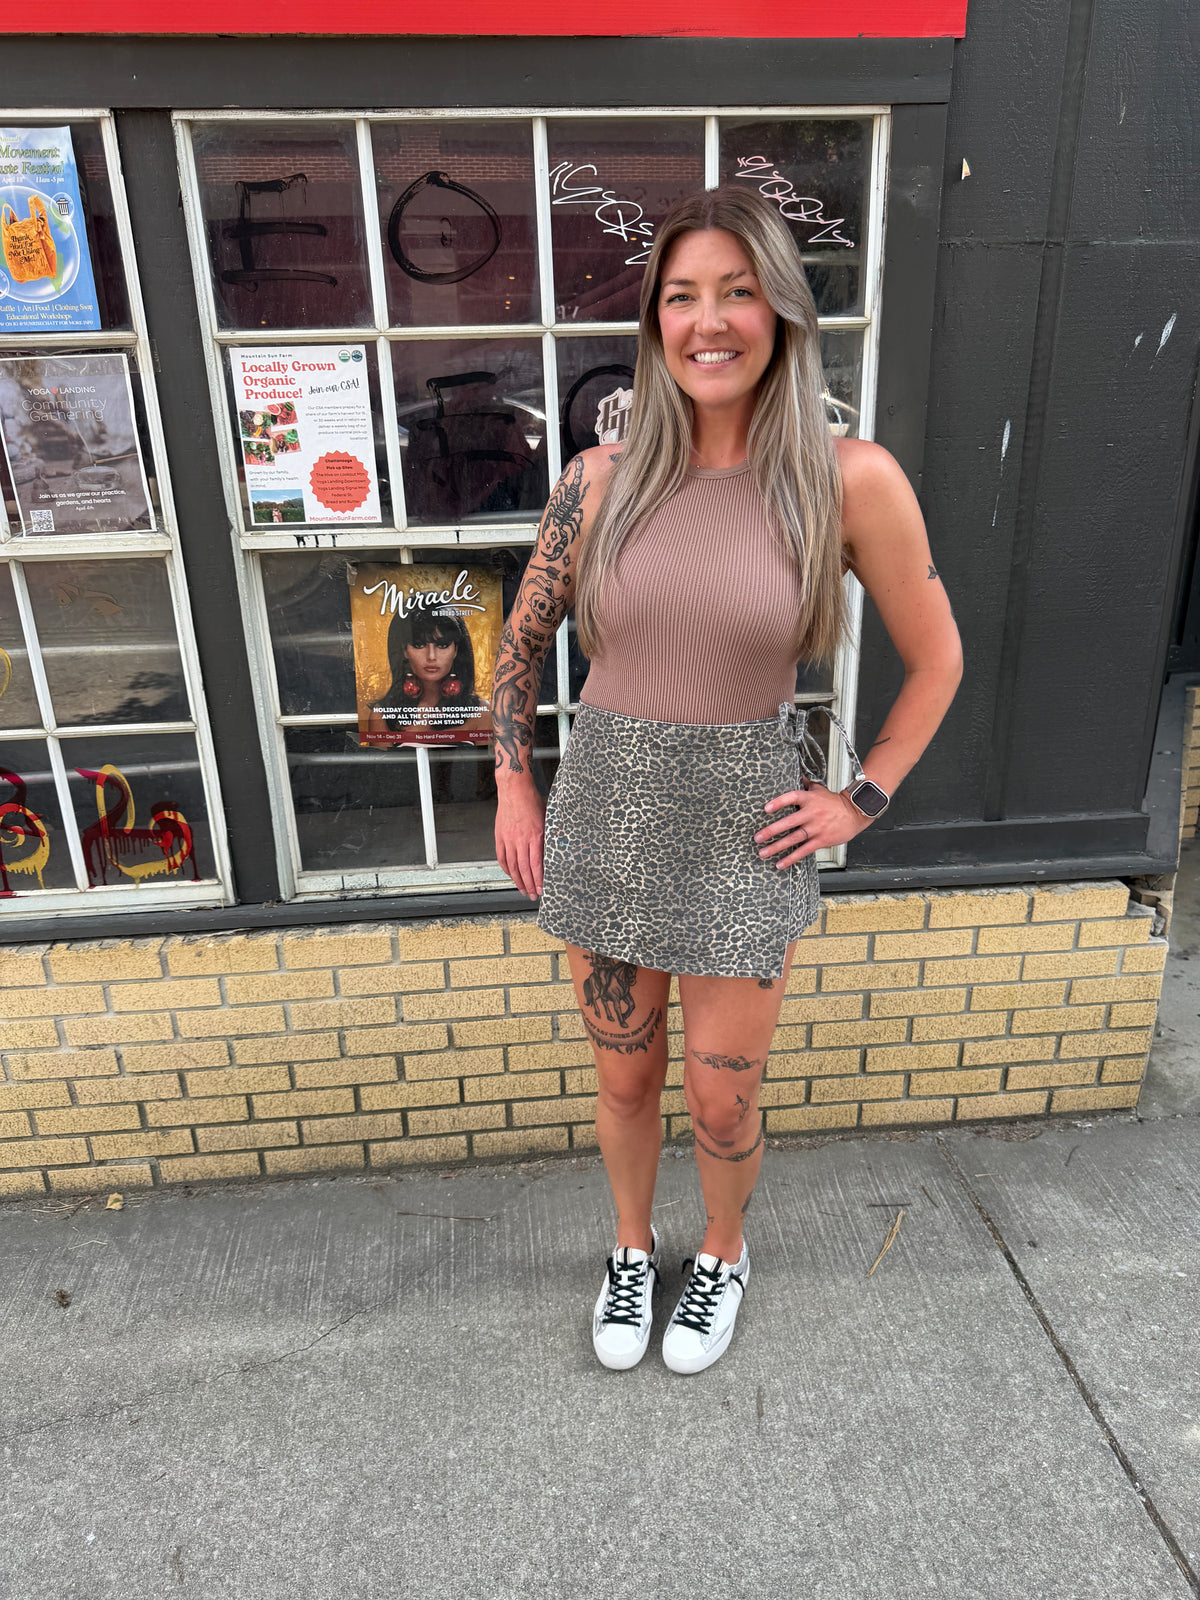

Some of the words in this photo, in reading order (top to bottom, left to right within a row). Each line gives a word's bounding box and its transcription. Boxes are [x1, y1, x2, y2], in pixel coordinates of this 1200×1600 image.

[22, 161, 64, 175] Festival
[55, 304, 79, 312] Clothing
[6, 313, 39, 321] Educational
[40, 312, 72, 321] Workshops
[241, 361, 288, 374] Locally
[291, 361, 336, 372] Grown
[243, 375, 296, 388] Organic
[308, 385, 323, 395] Join
[340, 377, 360, 390] CSA!
[28, 388, 51, 396] YOGA
[59, 386, 96, 395] LANDING
[245, 388, 303, 400] Produce!
[22, 397, 107, 411] Community
[29, 408, 104, 422] Gathering
[363, 569, 480, 619] Miracle
